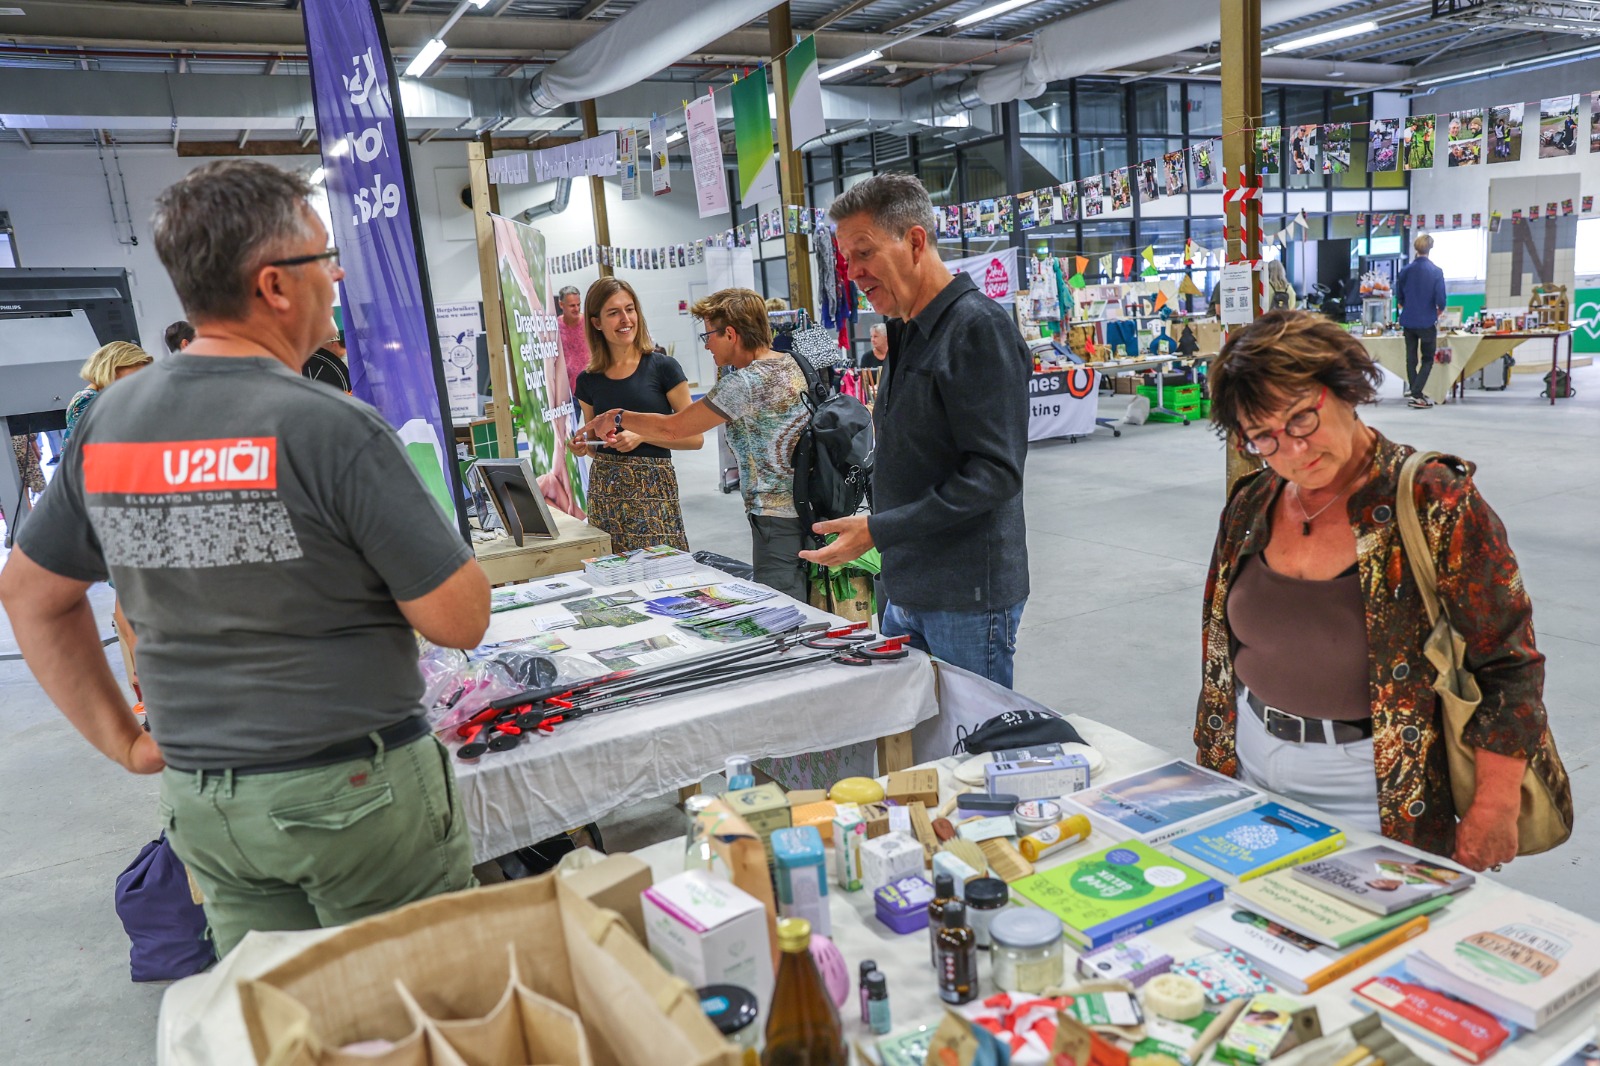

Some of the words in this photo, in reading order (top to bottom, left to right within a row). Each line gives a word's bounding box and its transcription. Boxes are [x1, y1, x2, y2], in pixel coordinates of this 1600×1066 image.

[513, 309, 537, 338] Draag
[535, 310, 547, 338] bij
[545, 315, 559, 332] aan
[520, 342, 534, 362] een
[533, 340, 559, 360] schone
[523, 366, 546, 391] buurt
[1029, 376, 1060, 393] nes
[1031, 404, 1060, 417] ting
[163, 448, 216, 485] U2
[125, 493, 192, 504] ELEVATION
[198, 491, 233, 501] TOUR
[1301, 864, 1369, 895] CIRCULAR
[1315, 861, 1359, 881] CHEFS
[1298, 900, 1335, 925] Minder
